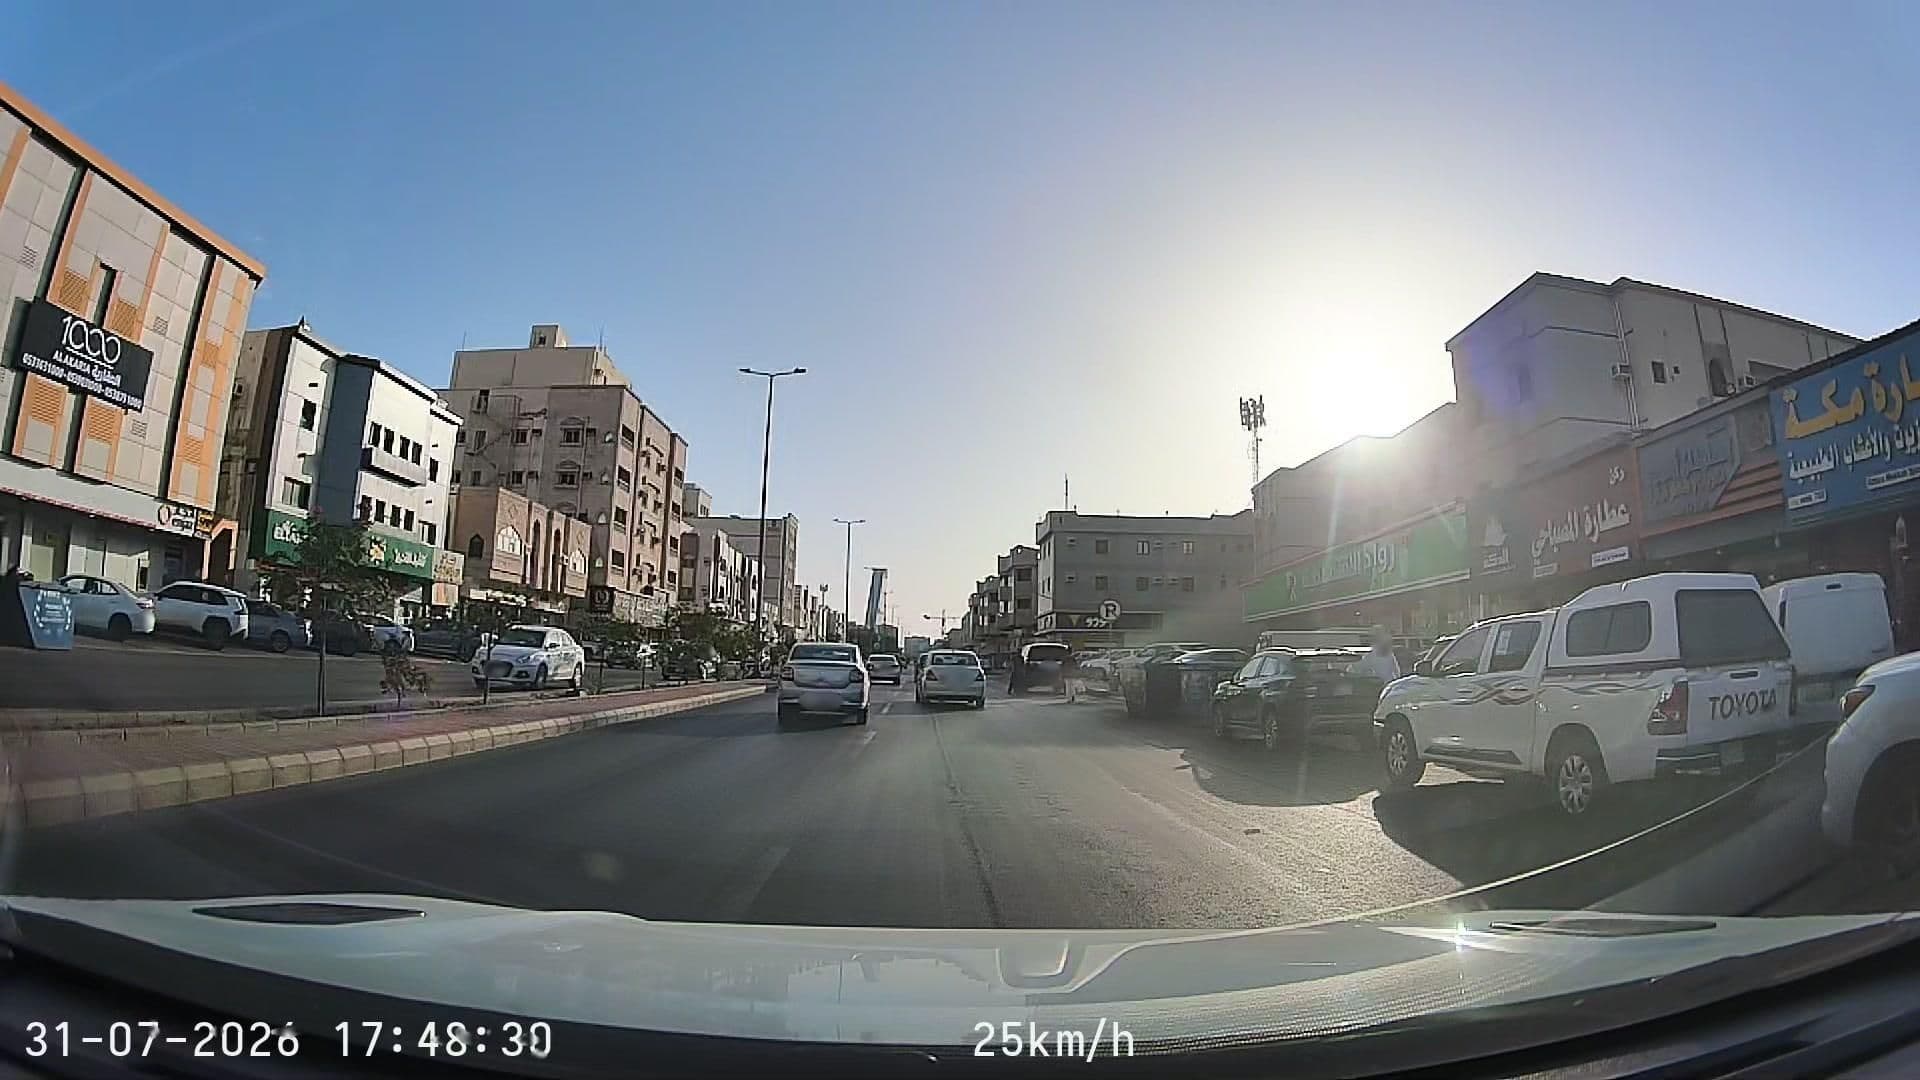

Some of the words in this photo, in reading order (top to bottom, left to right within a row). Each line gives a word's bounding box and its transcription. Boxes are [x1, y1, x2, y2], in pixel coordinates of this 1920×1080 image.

[62, 315, 120, 364] 1000
[1784, 377, 1865, 440] مكة
[1583, 497, 1631, 543] عطارة
[1707, 687, 1777, 721] TOYOTA
